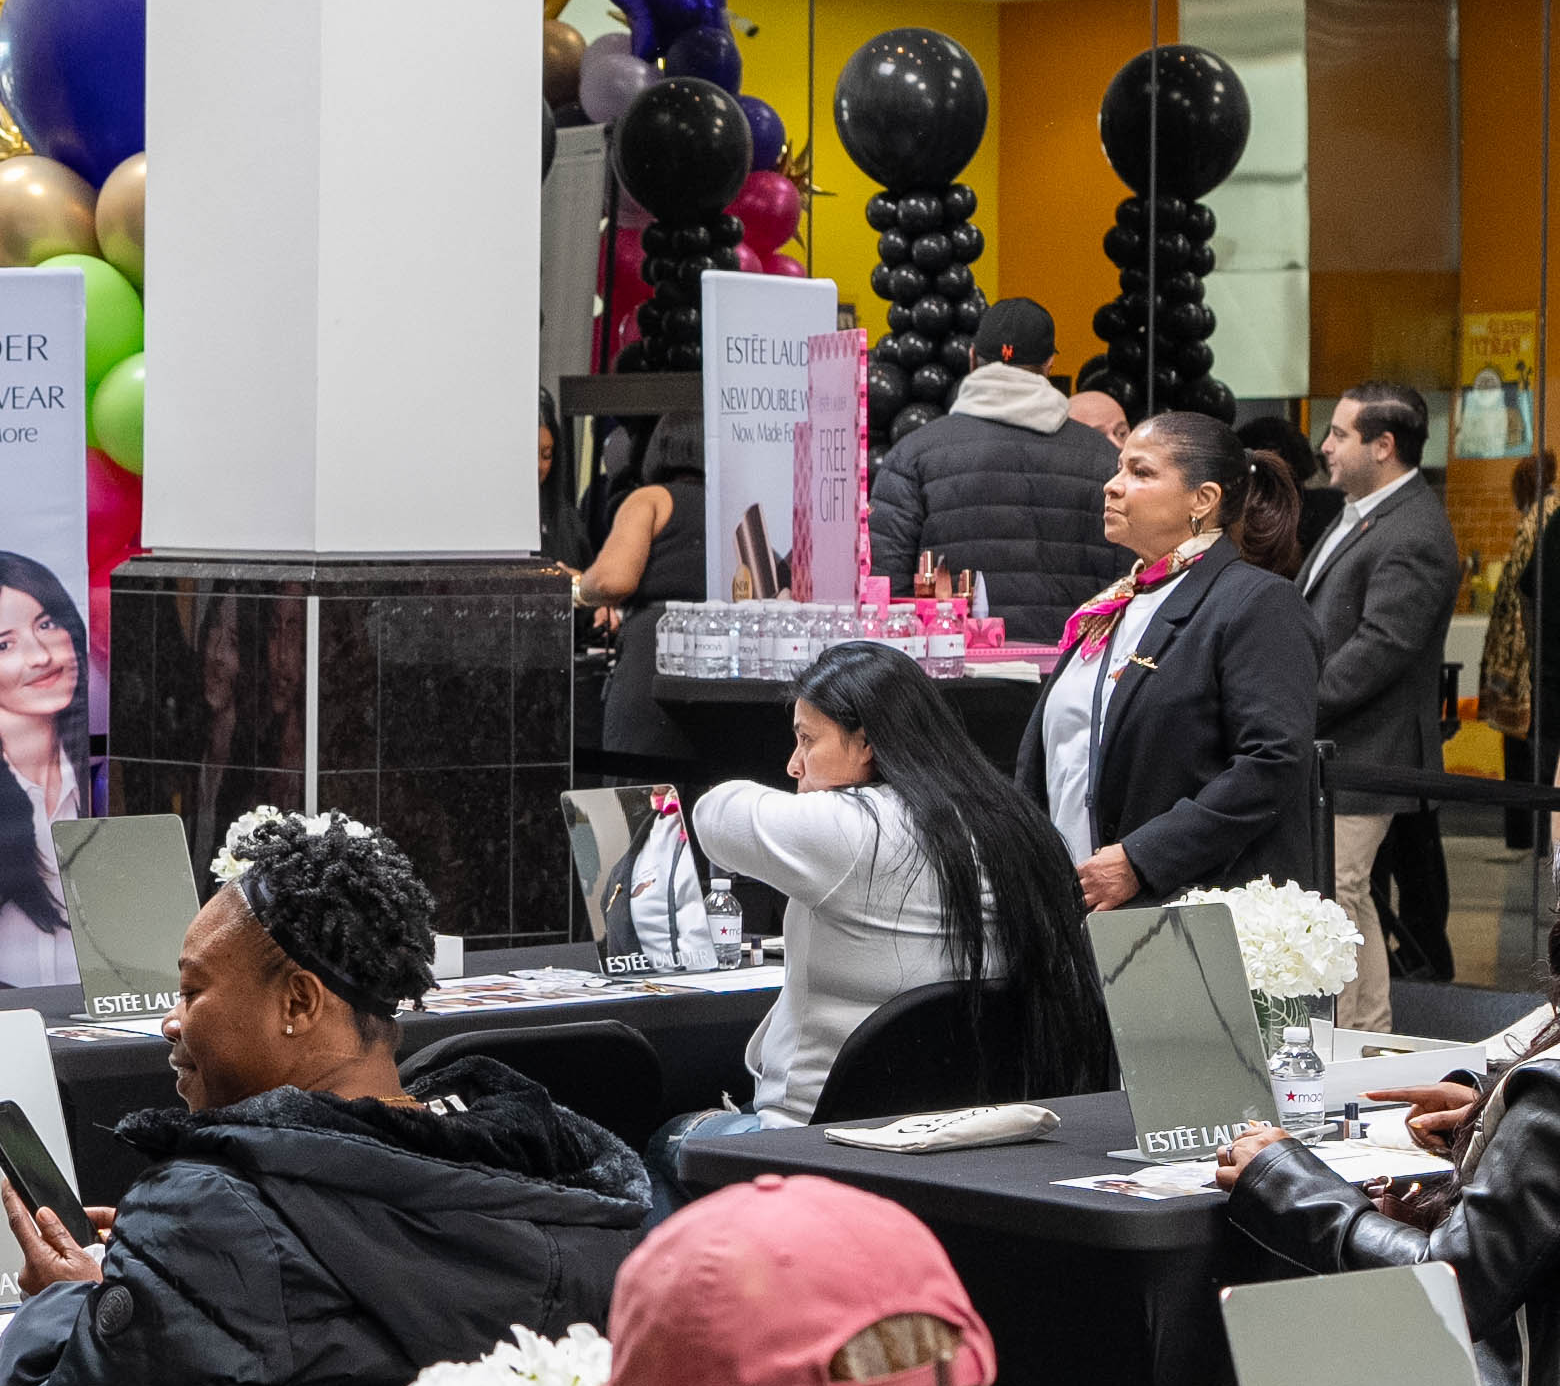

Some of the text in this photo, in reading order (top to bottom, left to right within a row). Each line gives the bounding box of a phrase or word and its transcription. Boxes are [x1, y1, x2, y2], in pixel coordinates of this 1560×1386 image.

[771, 340, 809, 367] LAUD
[720, 387, 750, 411] NEW
[751, 387, 798, 413] DOUBLE
[731, 422, 756, 445] Now,
[758, 421, 782, 443] Made
[819, 428, 847, 473] FREE
[819, 476, 848, 523] GIFT
